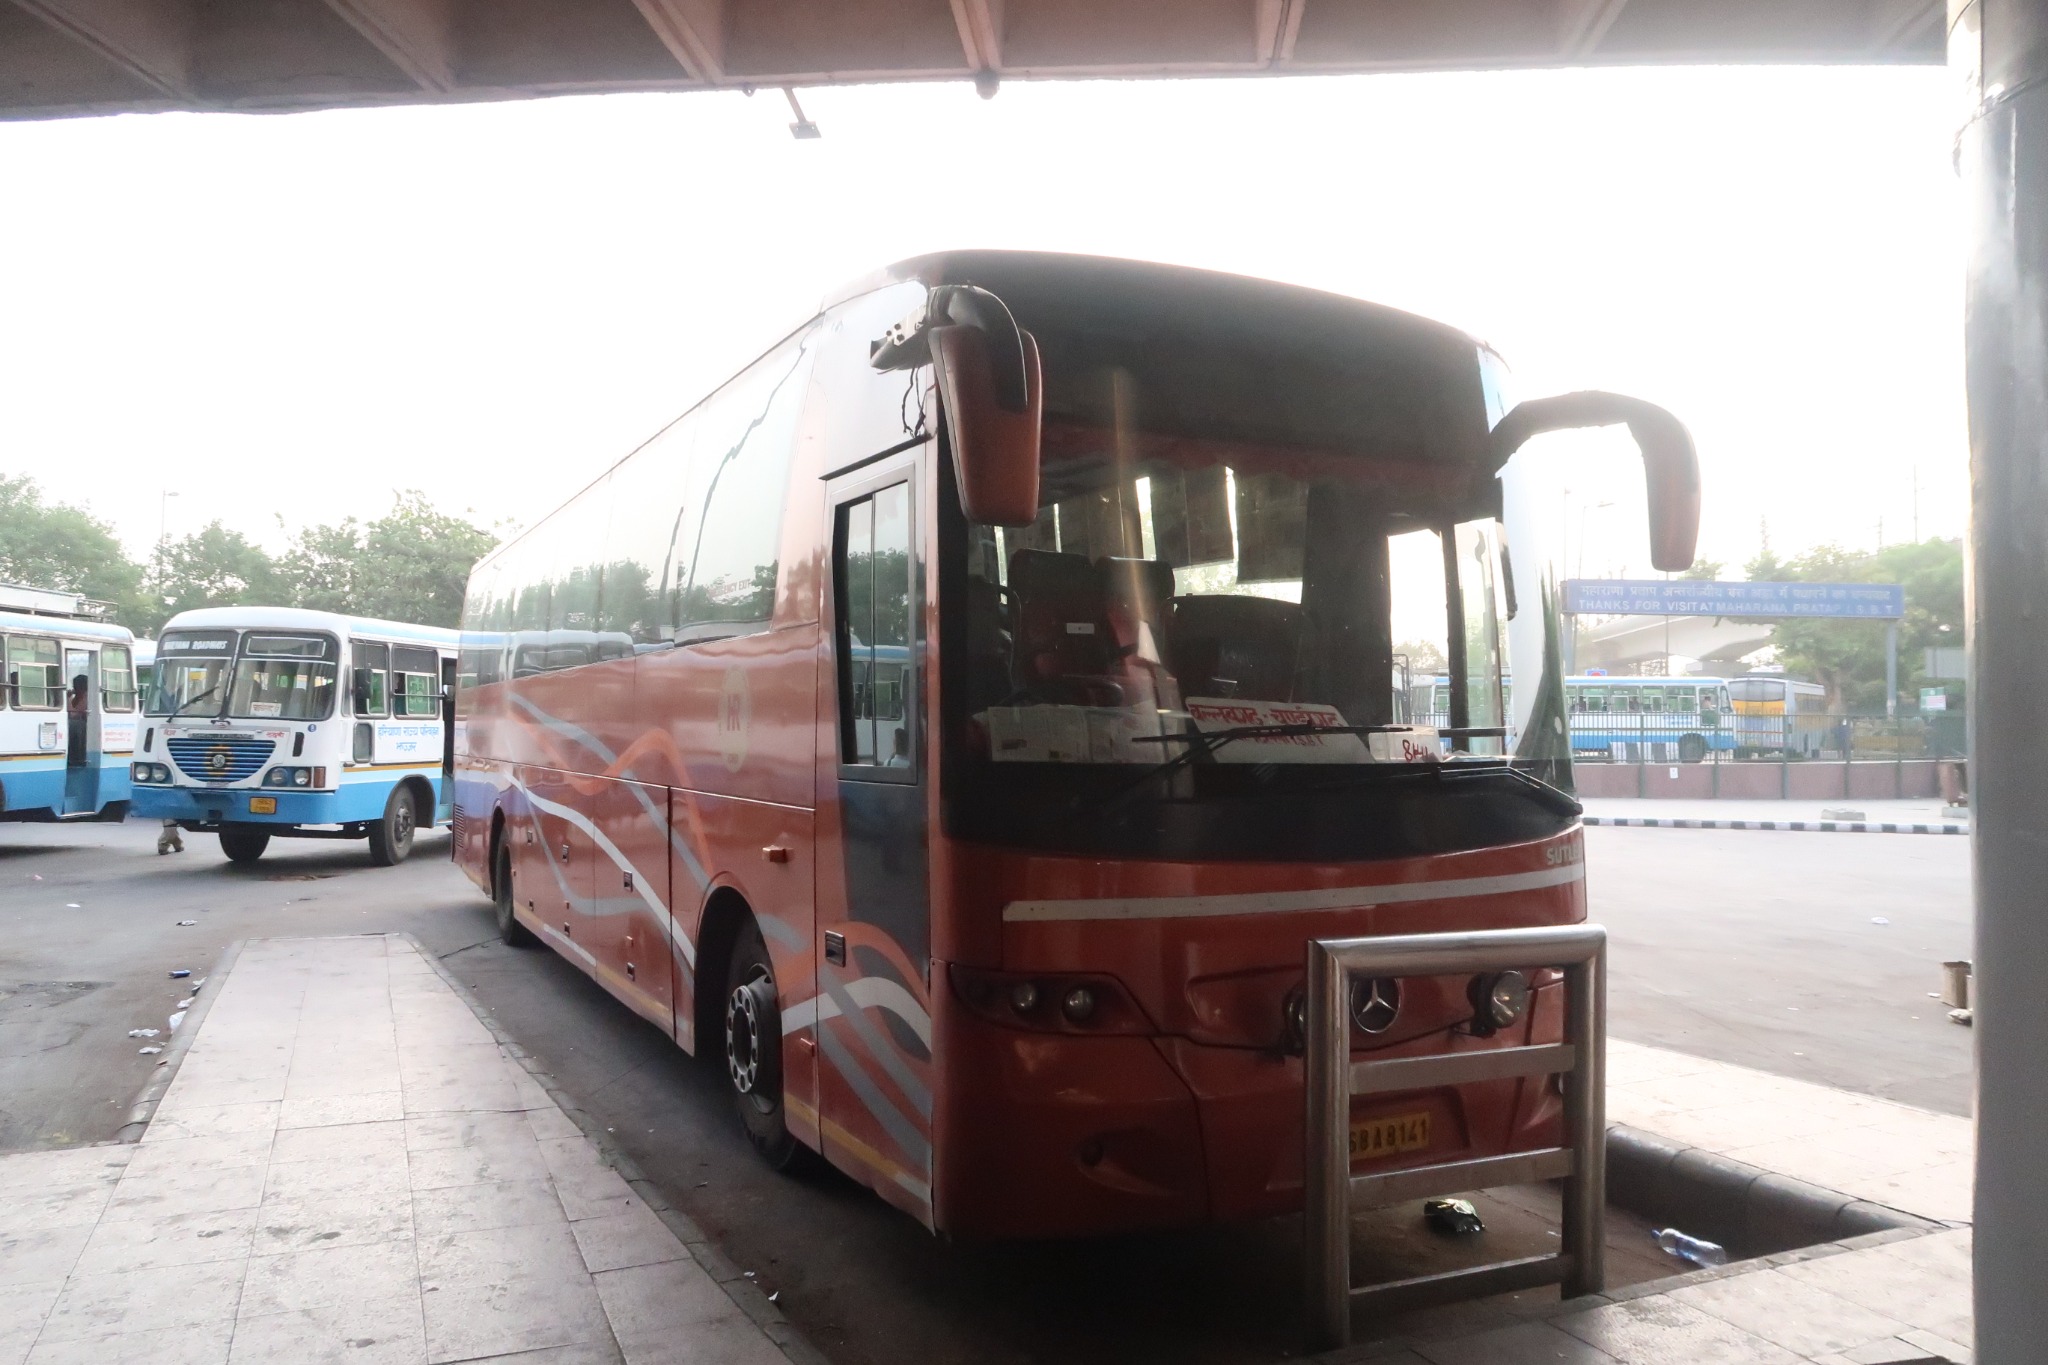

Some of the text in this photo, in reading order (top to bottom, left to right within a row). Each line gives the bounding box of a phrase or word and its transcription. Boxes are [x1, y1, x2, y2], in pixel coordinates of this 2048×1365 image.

[1581, 585, 1625, 597] महाराणा
[1630, 585, 1657, 597] प्रताप
[1578, 600, 1630, 610] THANKS
[1634, 600, 1661, 611] FOR
[1667, 601, 1698, 611] VISIT
[1699, 602, 1714, 612] AT
[1716, 602, 1786, 613] MAHARANA
[1793, 604, 1841, 614] PRATAP
